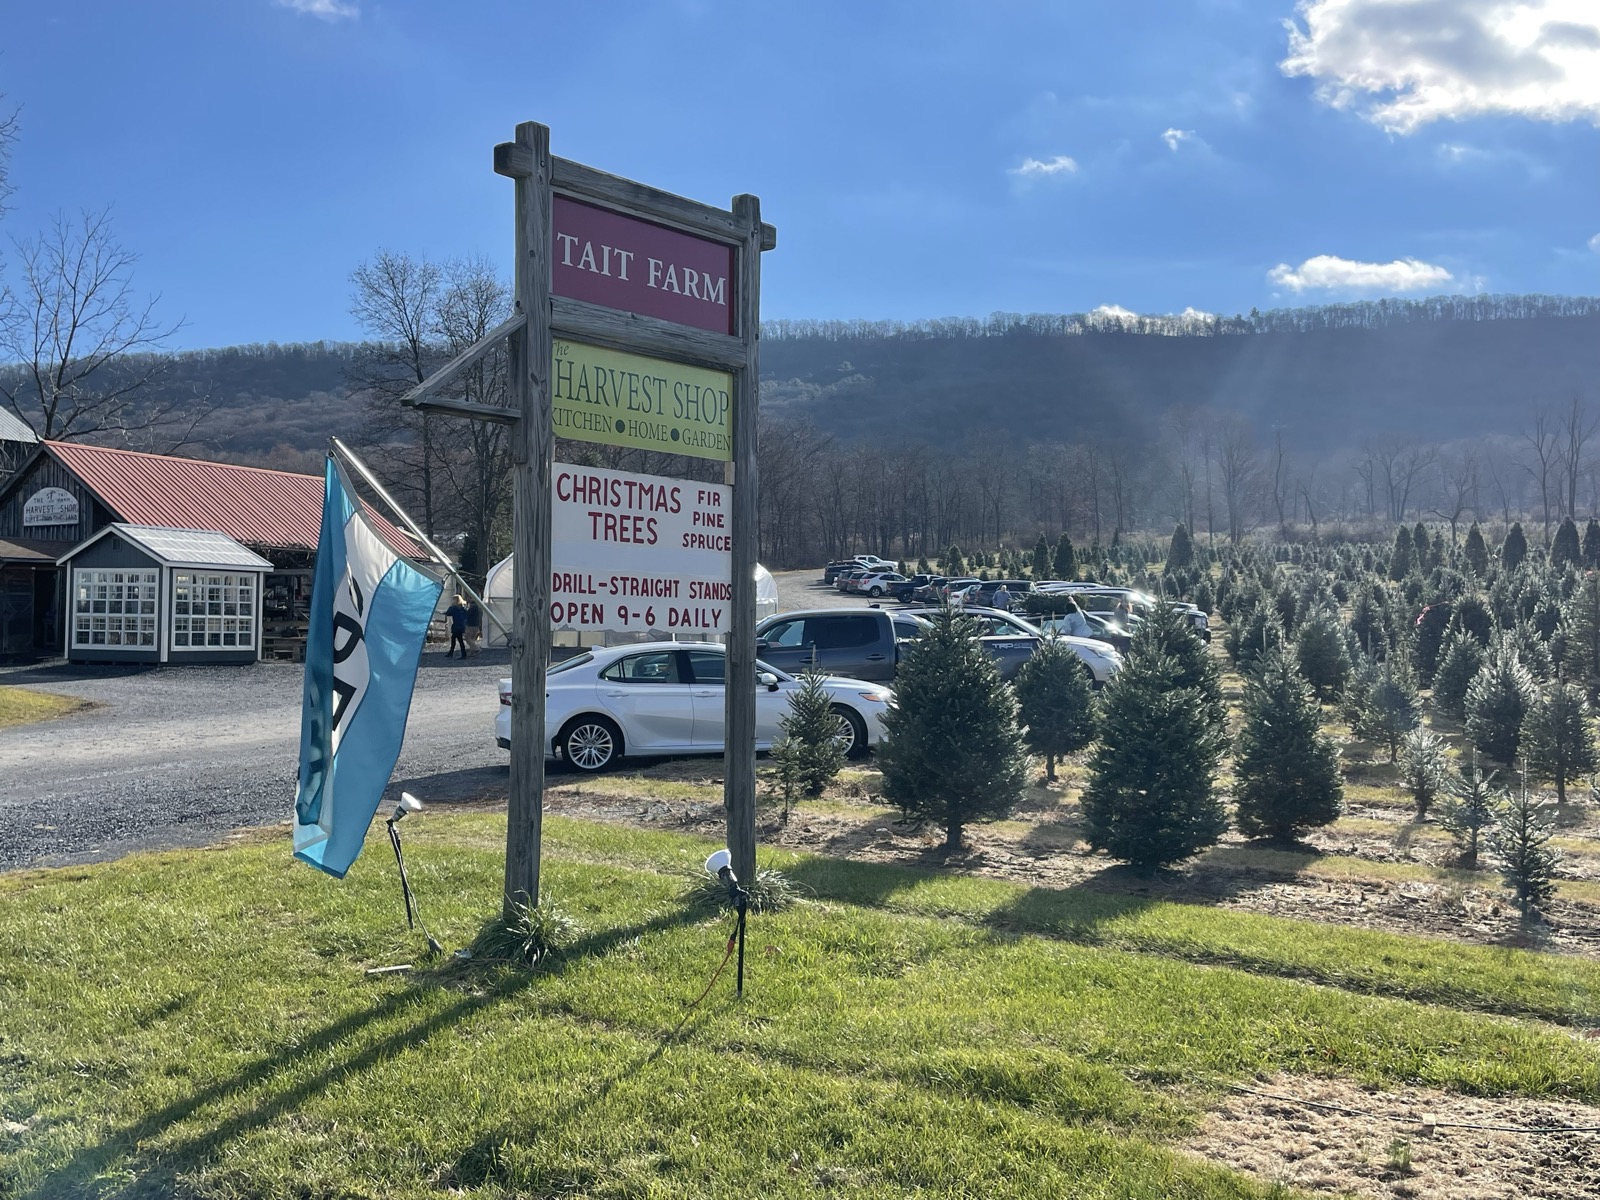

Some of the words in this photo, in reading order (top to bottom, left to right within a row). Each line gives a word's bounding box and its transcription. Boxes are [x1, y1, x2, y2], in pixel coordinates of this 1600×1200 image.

[557, 231, 634, 281] TAIT
[647, 257, 727, 306] FARM
[554, 358, 668, 415] HARVEST
[673, 381, 729, 426] SHOP
[552, 407, 612, 433] KITCHEN
[628, 419, 668, 441] HOME
[682, 428, 732, 451] GARDEN
[556, 472, 681, 514] CHRISTMAS
[698, 490, 721, 507] FIR
[25, 505, 54, 514] HARVEST
[693, 511, 725, 528] PINE
[587, 511, 658, 545] TREES
[682, 533, 731, 551] SPRUCE
[552, 572, 680, 598] DRILL-STRAIGHT
[689, 581, 732, 601] STANDS
[550, 602, 604, 624] OPEN
[617, 605, 656, 627] 9-6
[668, 607, 722, 628] DAILY
